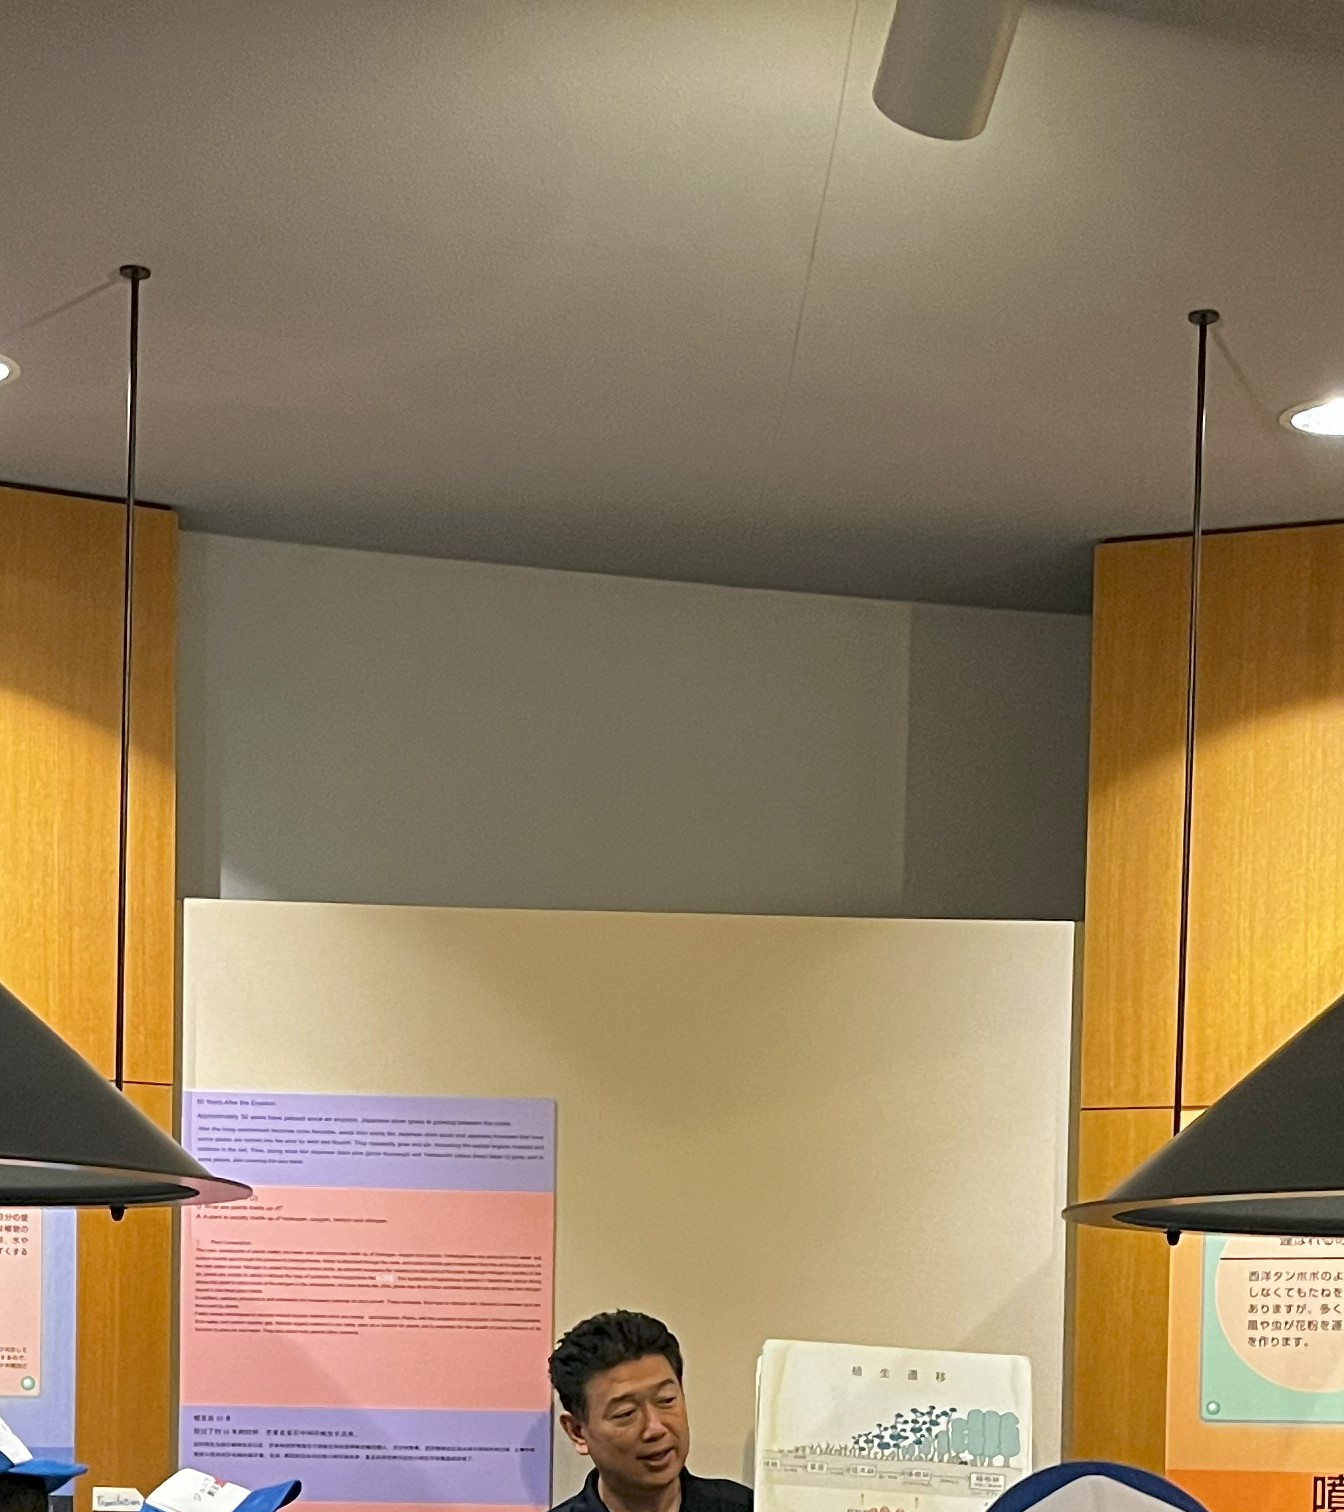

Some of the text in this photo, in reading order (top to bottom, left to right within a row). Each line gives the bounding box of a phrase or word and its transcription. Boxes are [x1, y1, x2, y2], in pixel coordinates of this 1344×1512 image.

[1247, 1336, 1309, 1348] を作ります。
